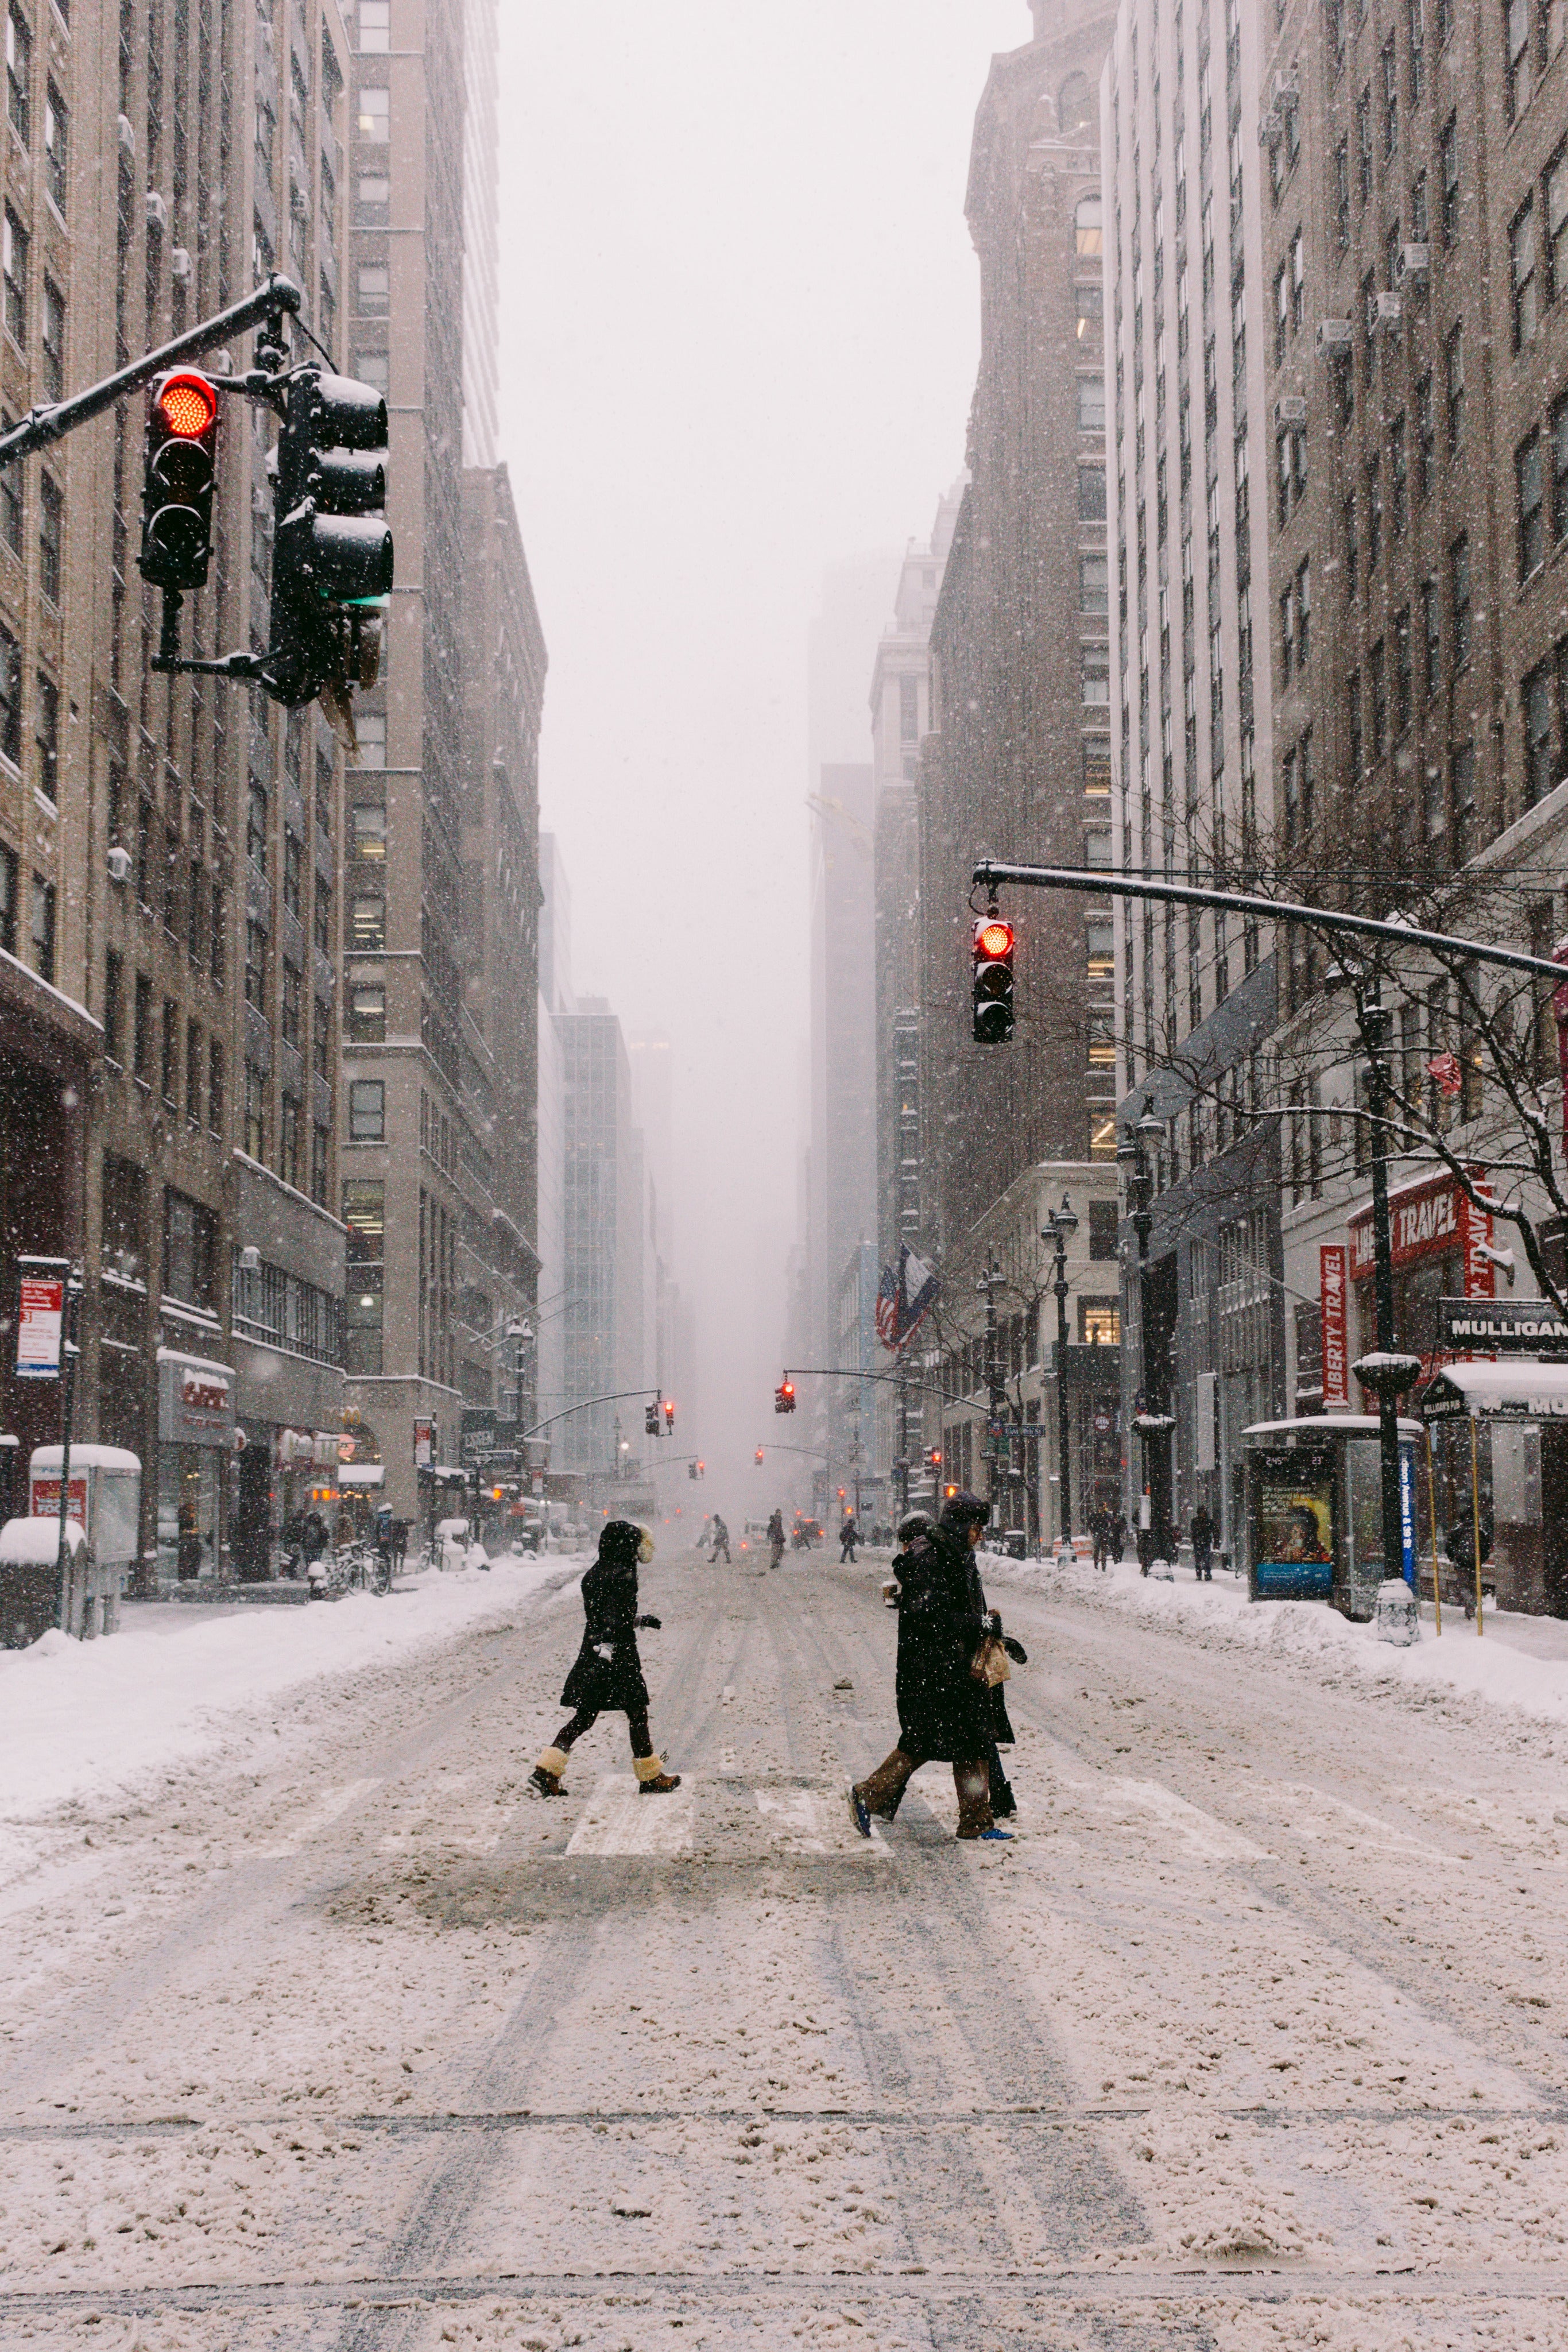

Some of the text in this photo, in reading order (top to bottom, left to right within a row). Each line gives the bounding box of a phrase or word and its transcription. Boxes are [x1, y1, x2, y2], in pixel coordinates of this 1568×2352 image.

[1399, 1192, 1456, 1248] TRAVEL
[1468, 1198, 1489, 1275] TRAVE
[1325, 1252, 1344, 1400] LIBERTY TRAVEL
[1401, 1484, 1410, 1516] Avenue
[1403, 1526, 1412, 1537] 39
[1403, 1538, 1412, 1549] St
